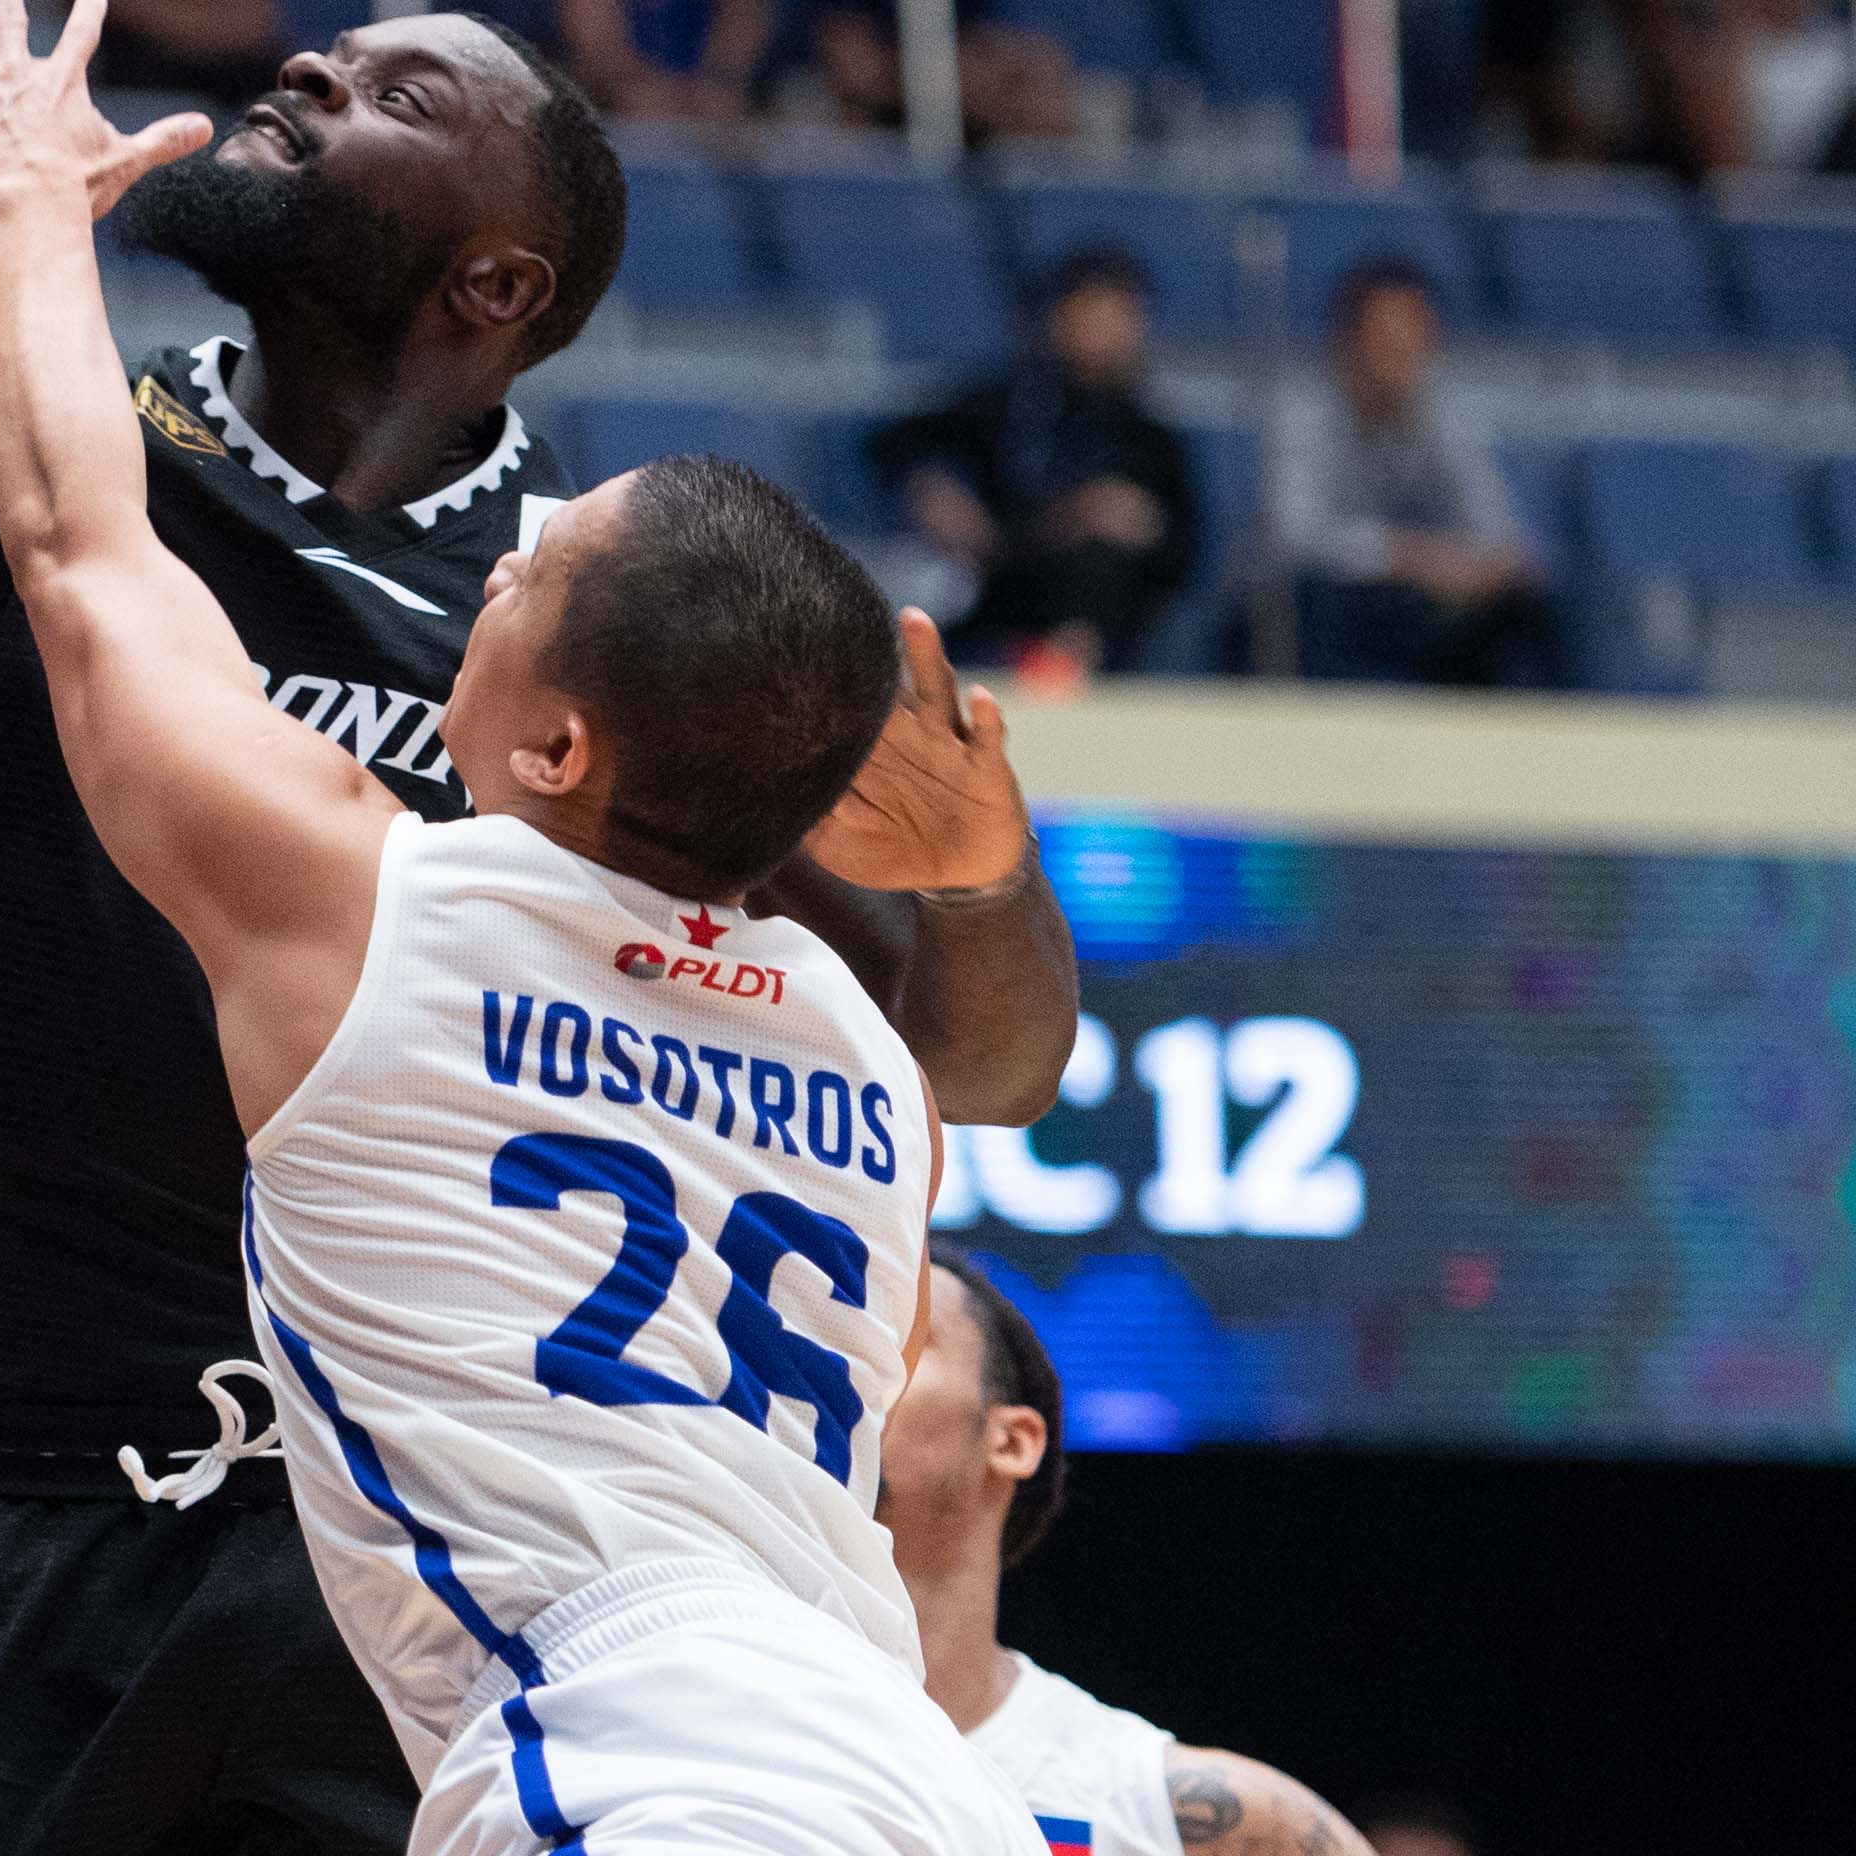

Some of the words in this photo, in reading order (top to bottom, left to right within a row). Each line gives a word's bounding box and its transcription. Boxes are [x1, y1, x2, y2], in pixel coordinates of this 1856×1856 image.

[667, 954, 787, 1005] PLDT
[482, 990, 896, 1185] VOSOTROS
[1133, 1013, 1367, 1238] 12
[489, 1131, 869, 1489] 26
